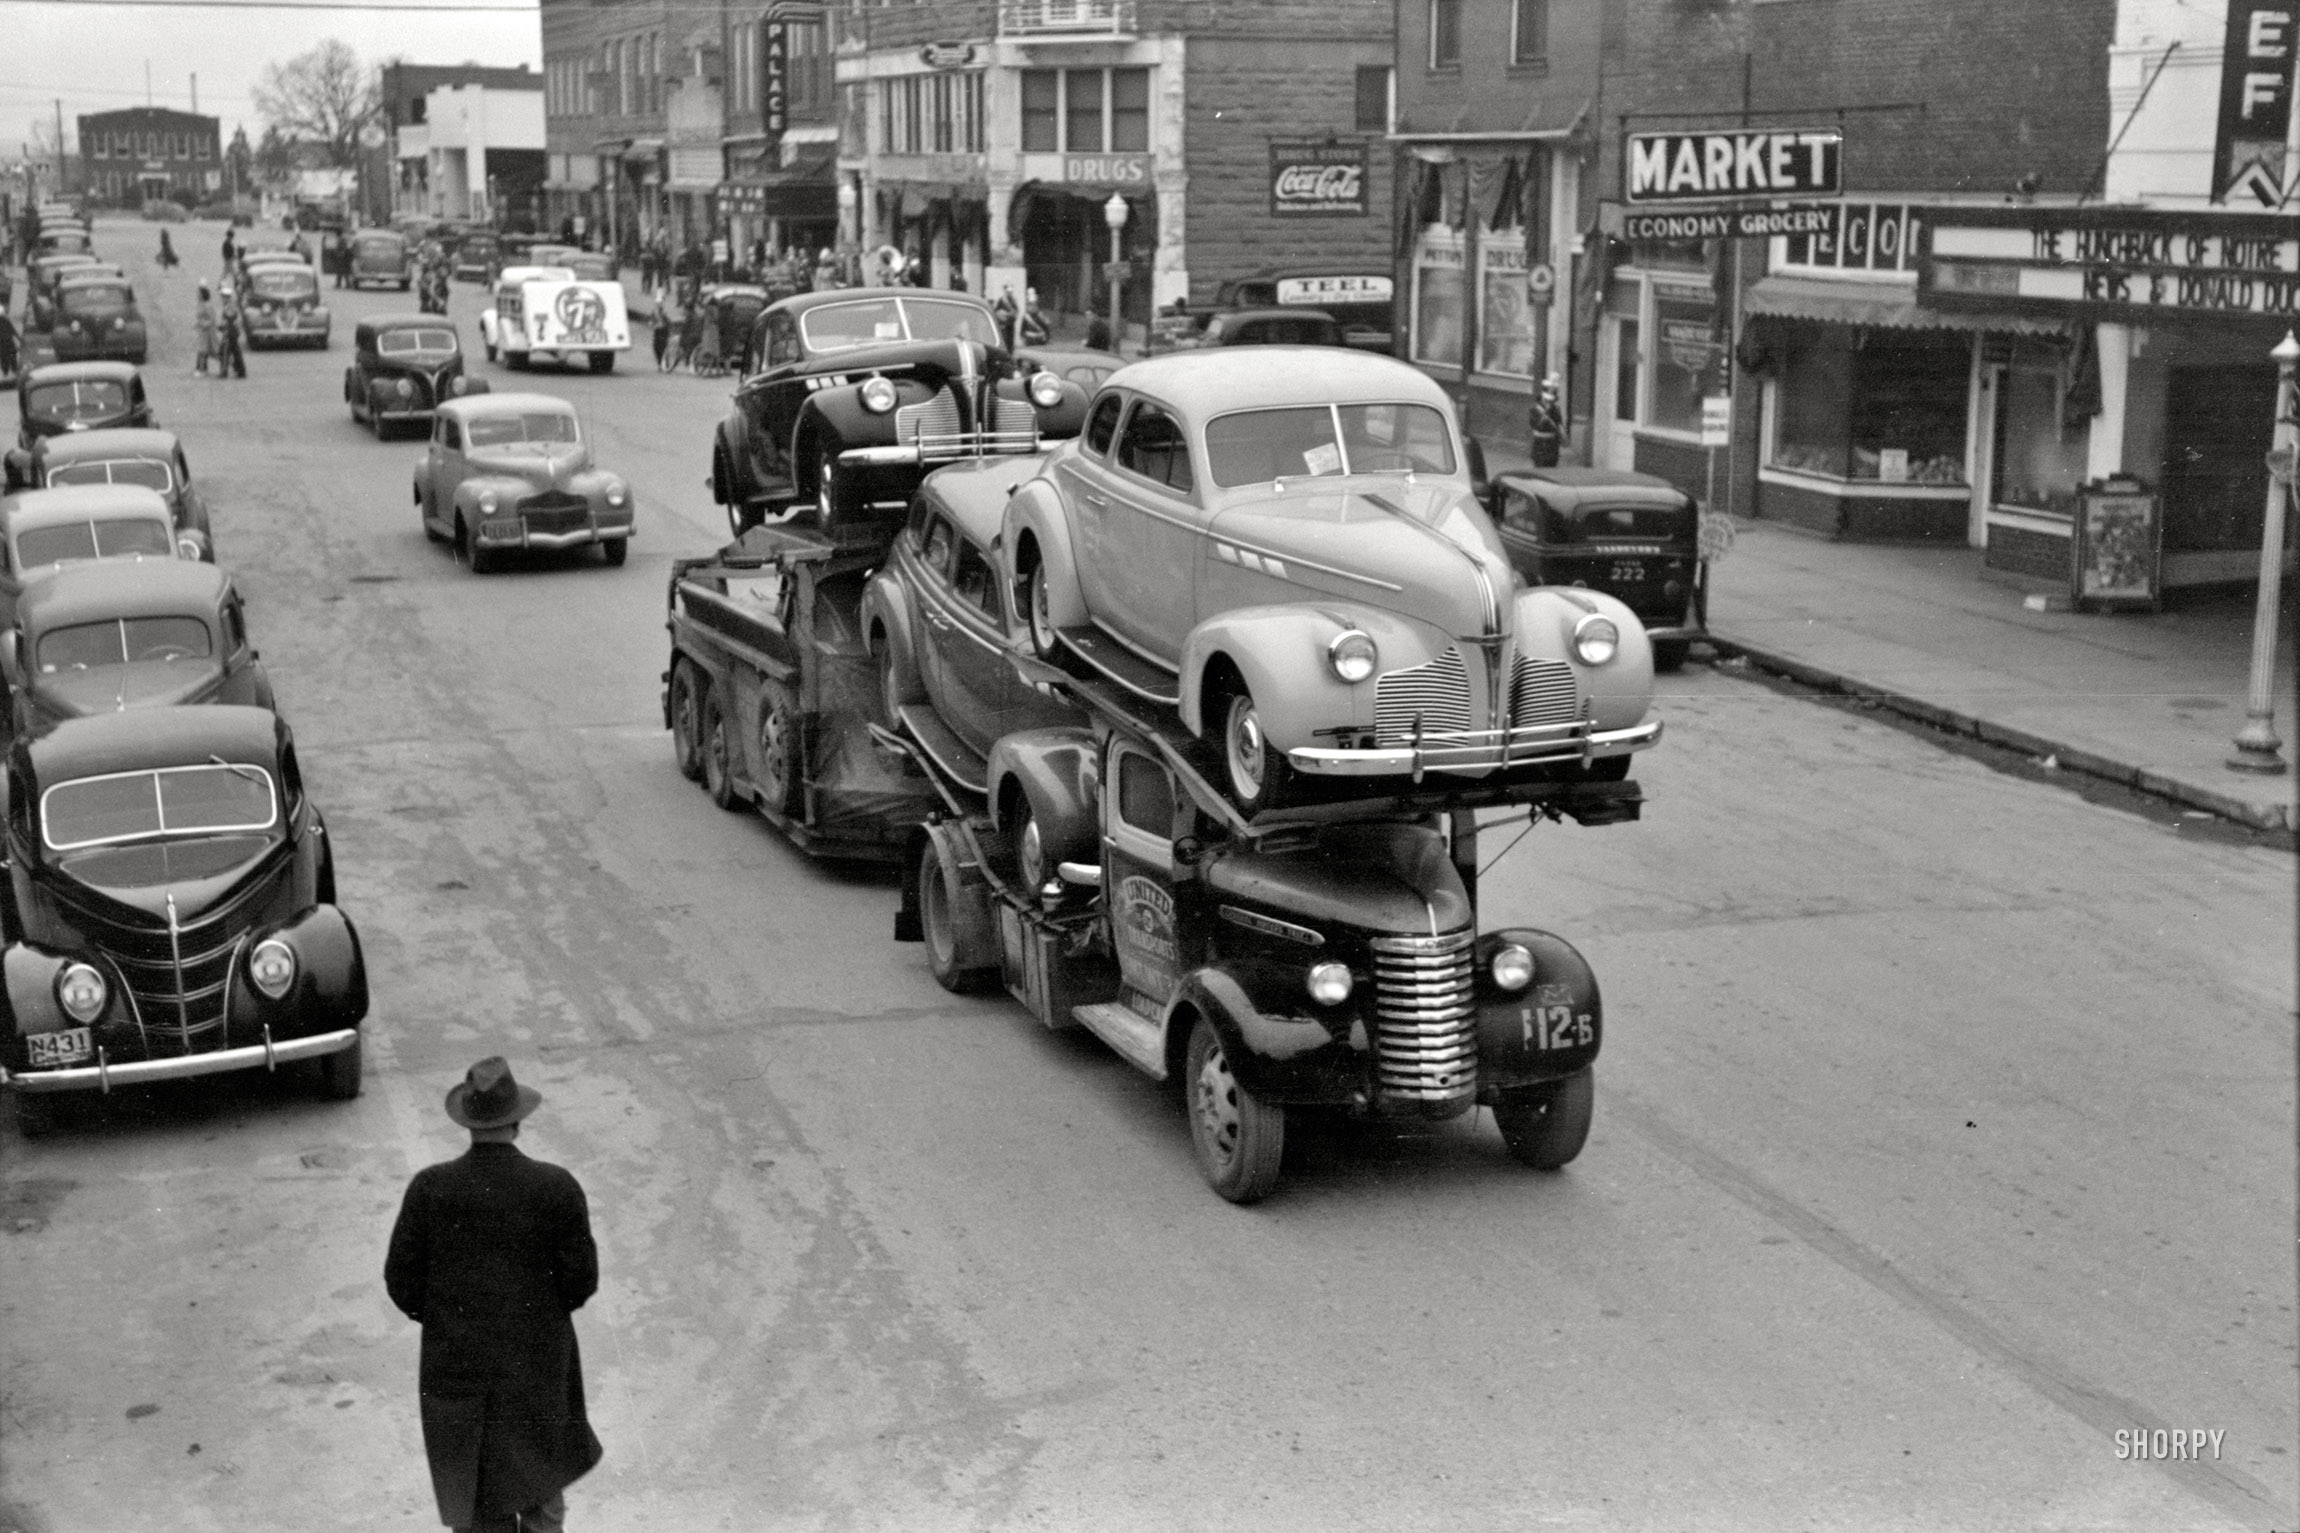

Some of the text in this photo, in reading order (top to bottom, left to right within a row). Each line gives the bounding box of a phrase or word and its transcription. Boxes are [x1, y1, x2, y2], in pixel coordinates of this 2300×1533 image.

[768, 23, 782, 130] PALACE
[1067, 159, 1143, 181] DRUGS
[1632, 133, 1839, 193] MARKET
[1628, 210, 1833, 239] ECONOMY GROCERY
[2030, 227, 2282, 272] THE HUNCHBACK OF NOTRE
[1298, 279, 1377, 292] TEEL
[2084, 270, 2132, 302] NEWS
[2178, 276, 2253, 311] DONALD
[1611, 567, 1645, 581] 222
[1126, 879, 1171, 916] UNITED
[31, 1032, 86, 1054] N431
